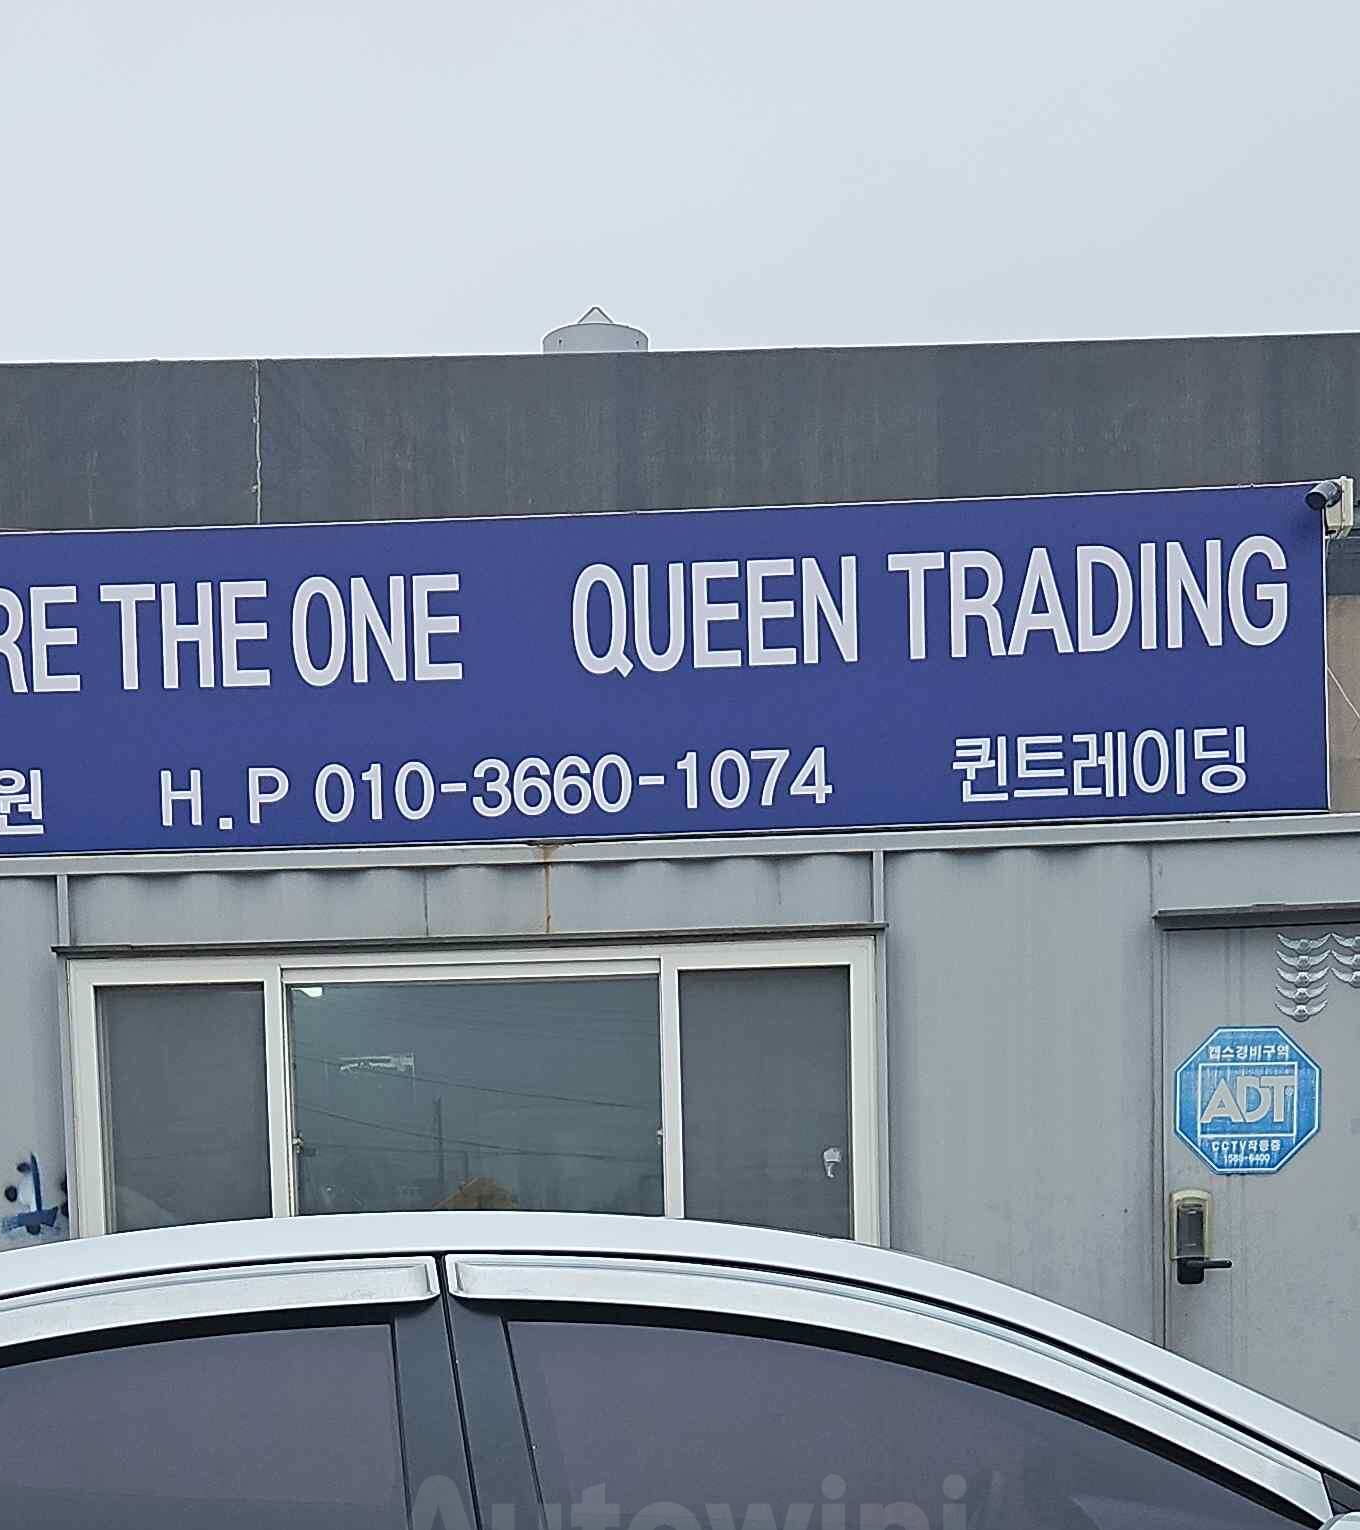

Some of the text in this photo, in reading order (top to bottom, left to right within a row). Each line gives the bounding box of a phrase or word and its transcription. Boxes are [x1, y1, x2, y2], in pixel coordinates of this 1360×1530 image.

[100, 582, 272, 691] THE
[293, 574, 464, 688] ONE
[572, 535, 1289, 679] QUEEN TRADING
[315, 745, 833, 825] 010-3660-1074
[952, 726, 1248, 804] 퀸트레이딩
[1199, 1075, 1297, 1123] ADT
